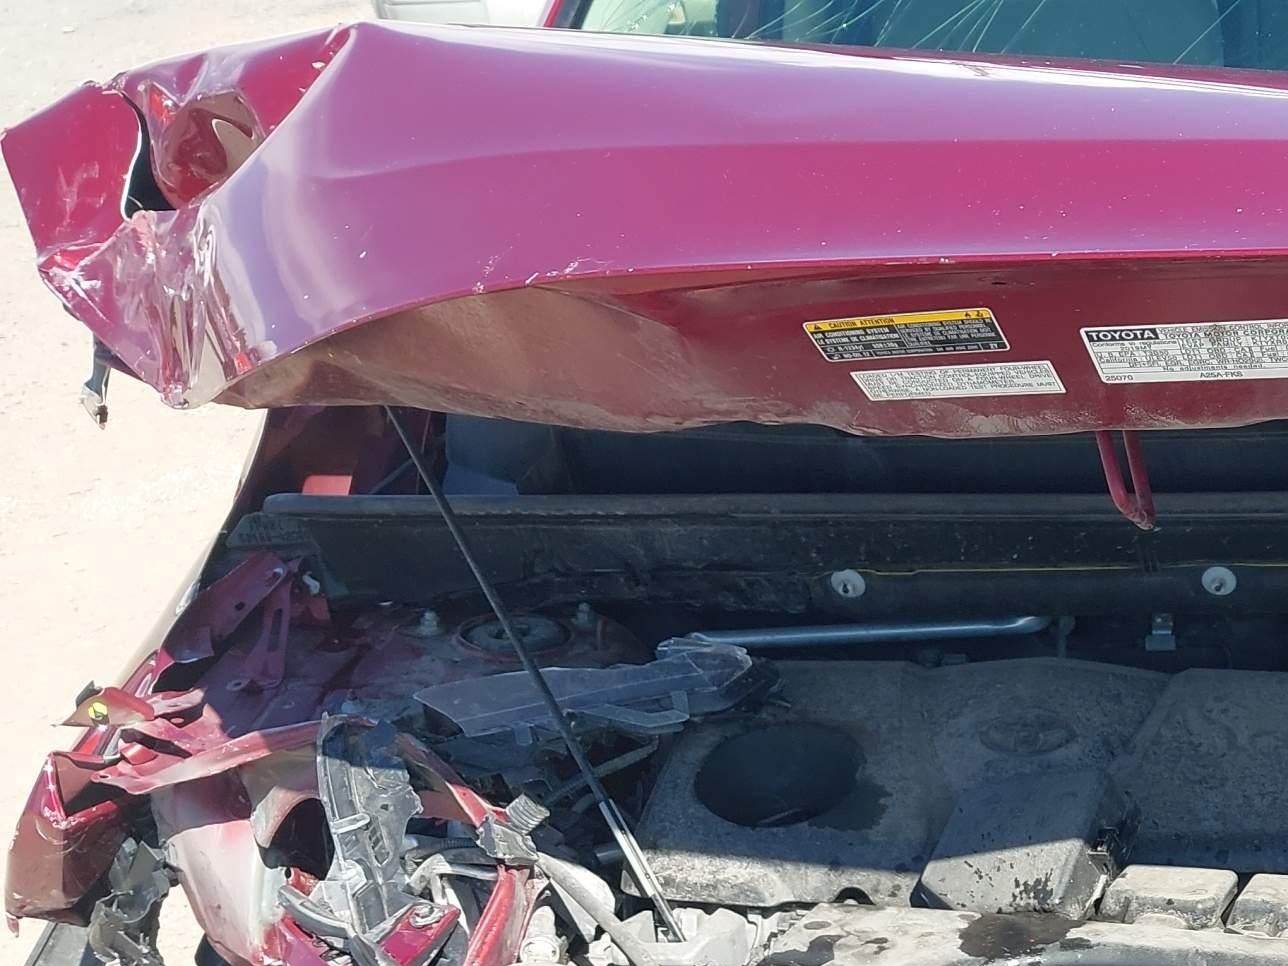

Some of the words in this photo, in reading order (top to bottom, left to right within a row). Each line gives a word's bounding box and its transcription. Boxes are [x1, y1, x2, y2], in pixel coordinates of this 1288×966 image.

[1088, 330, 1156, 341] TOYOTA
[1164, 332, 1200, 340] TOYOTA
[1204, 330, 1239, 338] MOTOR
